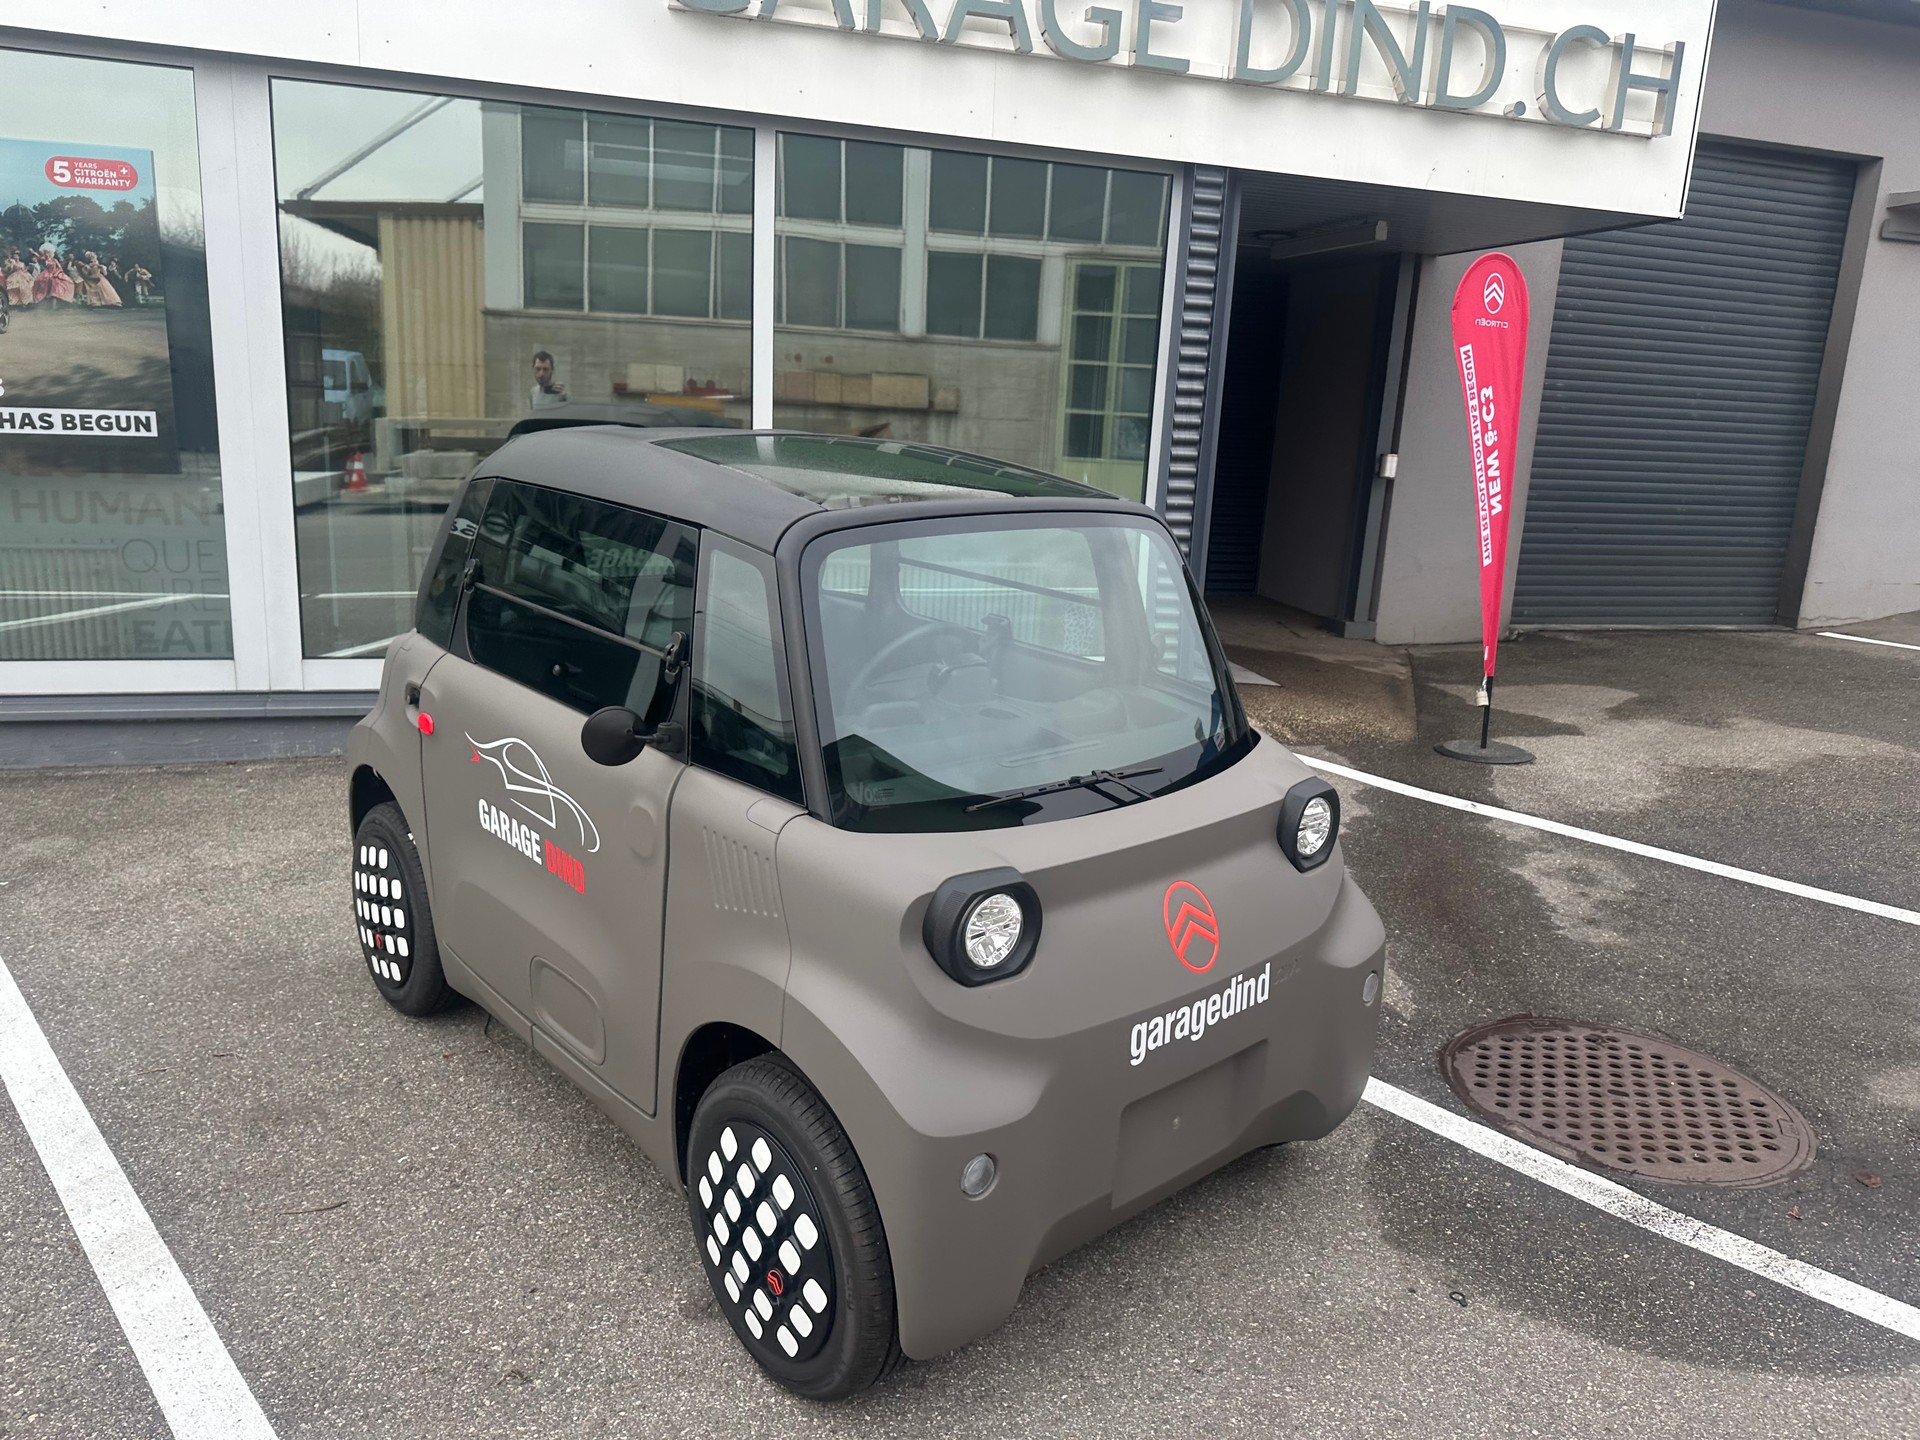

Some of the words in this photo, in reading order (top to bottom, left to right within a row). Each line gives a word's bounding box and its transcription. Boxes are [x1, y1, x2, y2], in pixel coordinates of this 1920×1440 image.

[1230, 0, 1685, 138] DIND.CH
[53, 160, 71, 183] 5
[74, 161, 97, 169] YEARS
[74, 168, 117, 179] CITROËN
[75, 176, 131, 188] WARRANTY
[0, 411, 55, 431] HAS
[60, 413, 153, 433] BEGUN
[10, 488, 211, 526] HUMAN
[478, 798, 543, 865] GARAGE
[545, 839, 585, 894] DIND
[1129, 961, 1271, 1066] garagedind
